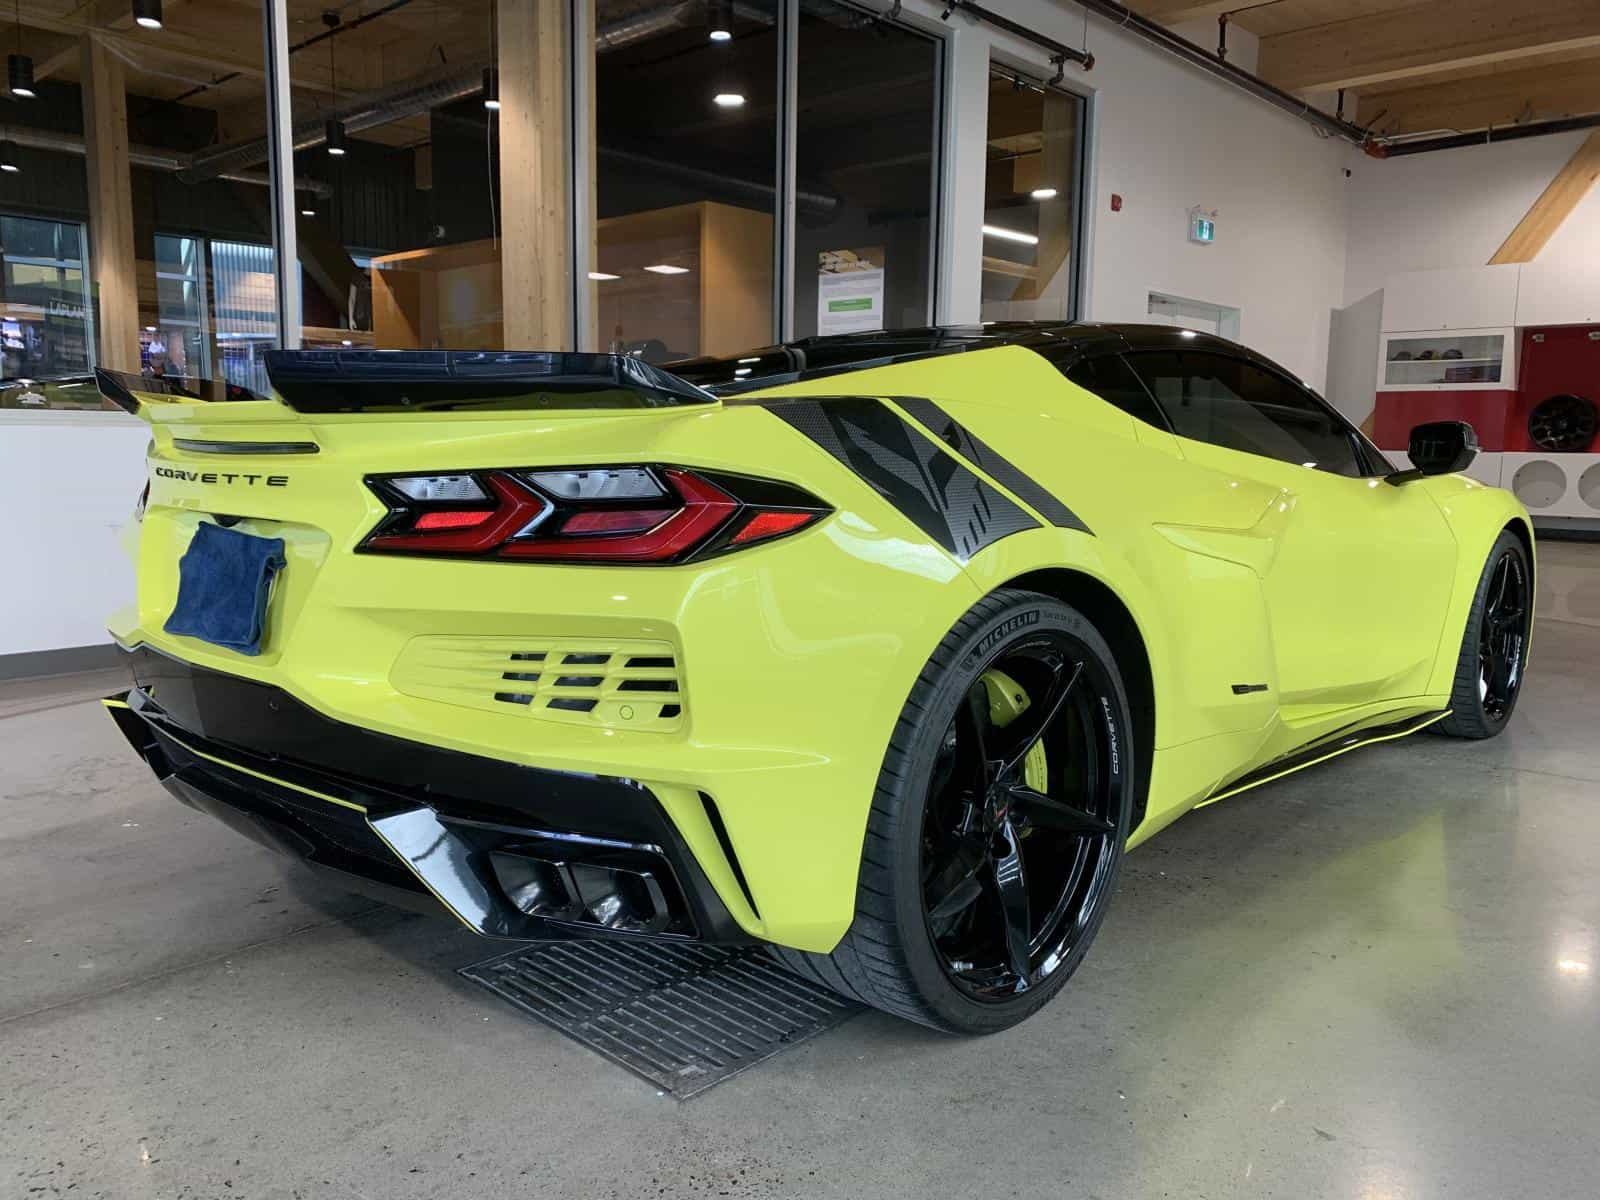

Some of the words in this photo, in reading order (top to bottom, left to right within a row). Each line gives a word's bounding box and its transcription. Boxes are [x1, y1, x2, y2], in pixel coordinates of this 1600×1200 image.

[155, 467, 289, 487] CORVETTE
[978, 610, 1038, 655] MICHELIN
[1101, 697, 1119, 775] CORVETTE
